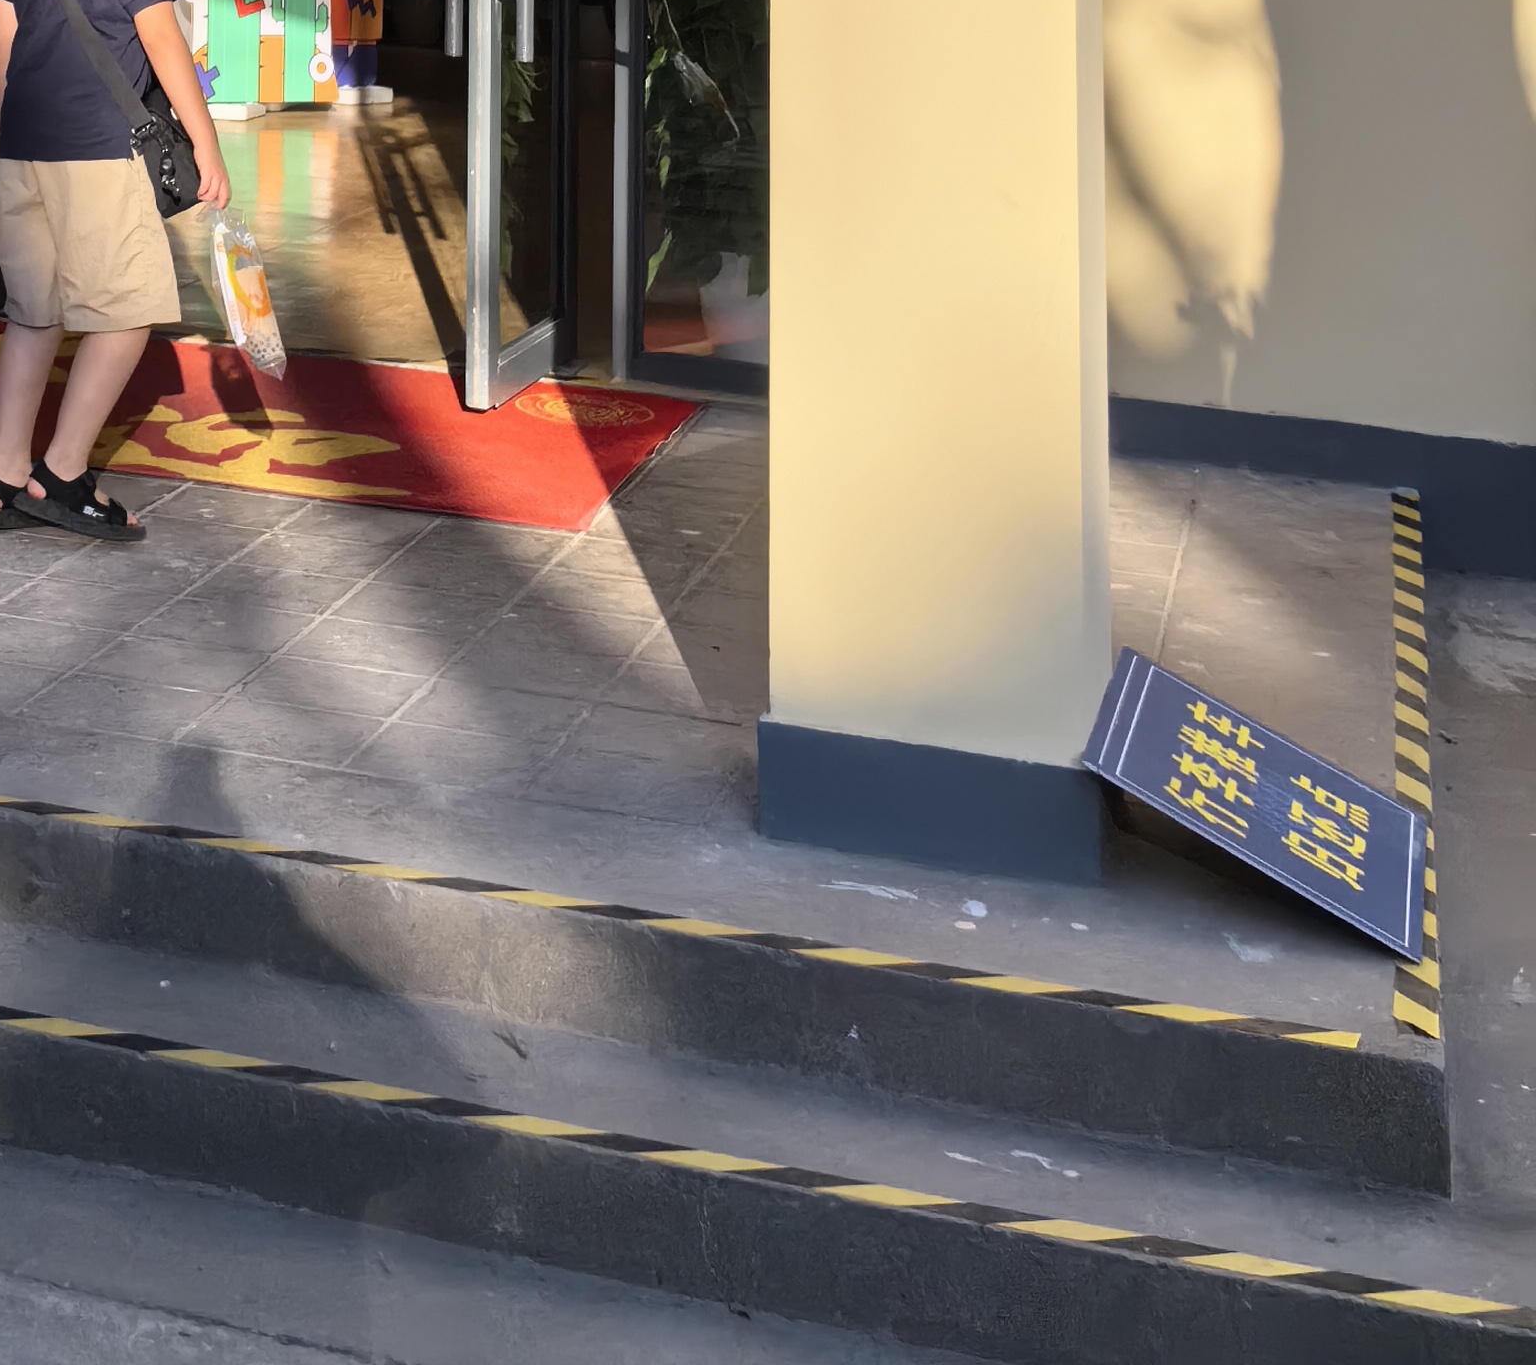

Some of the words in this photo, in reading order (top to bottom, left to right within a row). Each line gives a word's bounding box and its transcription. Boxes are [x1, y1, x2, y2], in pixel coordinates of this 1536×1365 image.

[1163, 700, 1265, 839] 行李推车
[1281, 775, 1369, 892] 归还点
